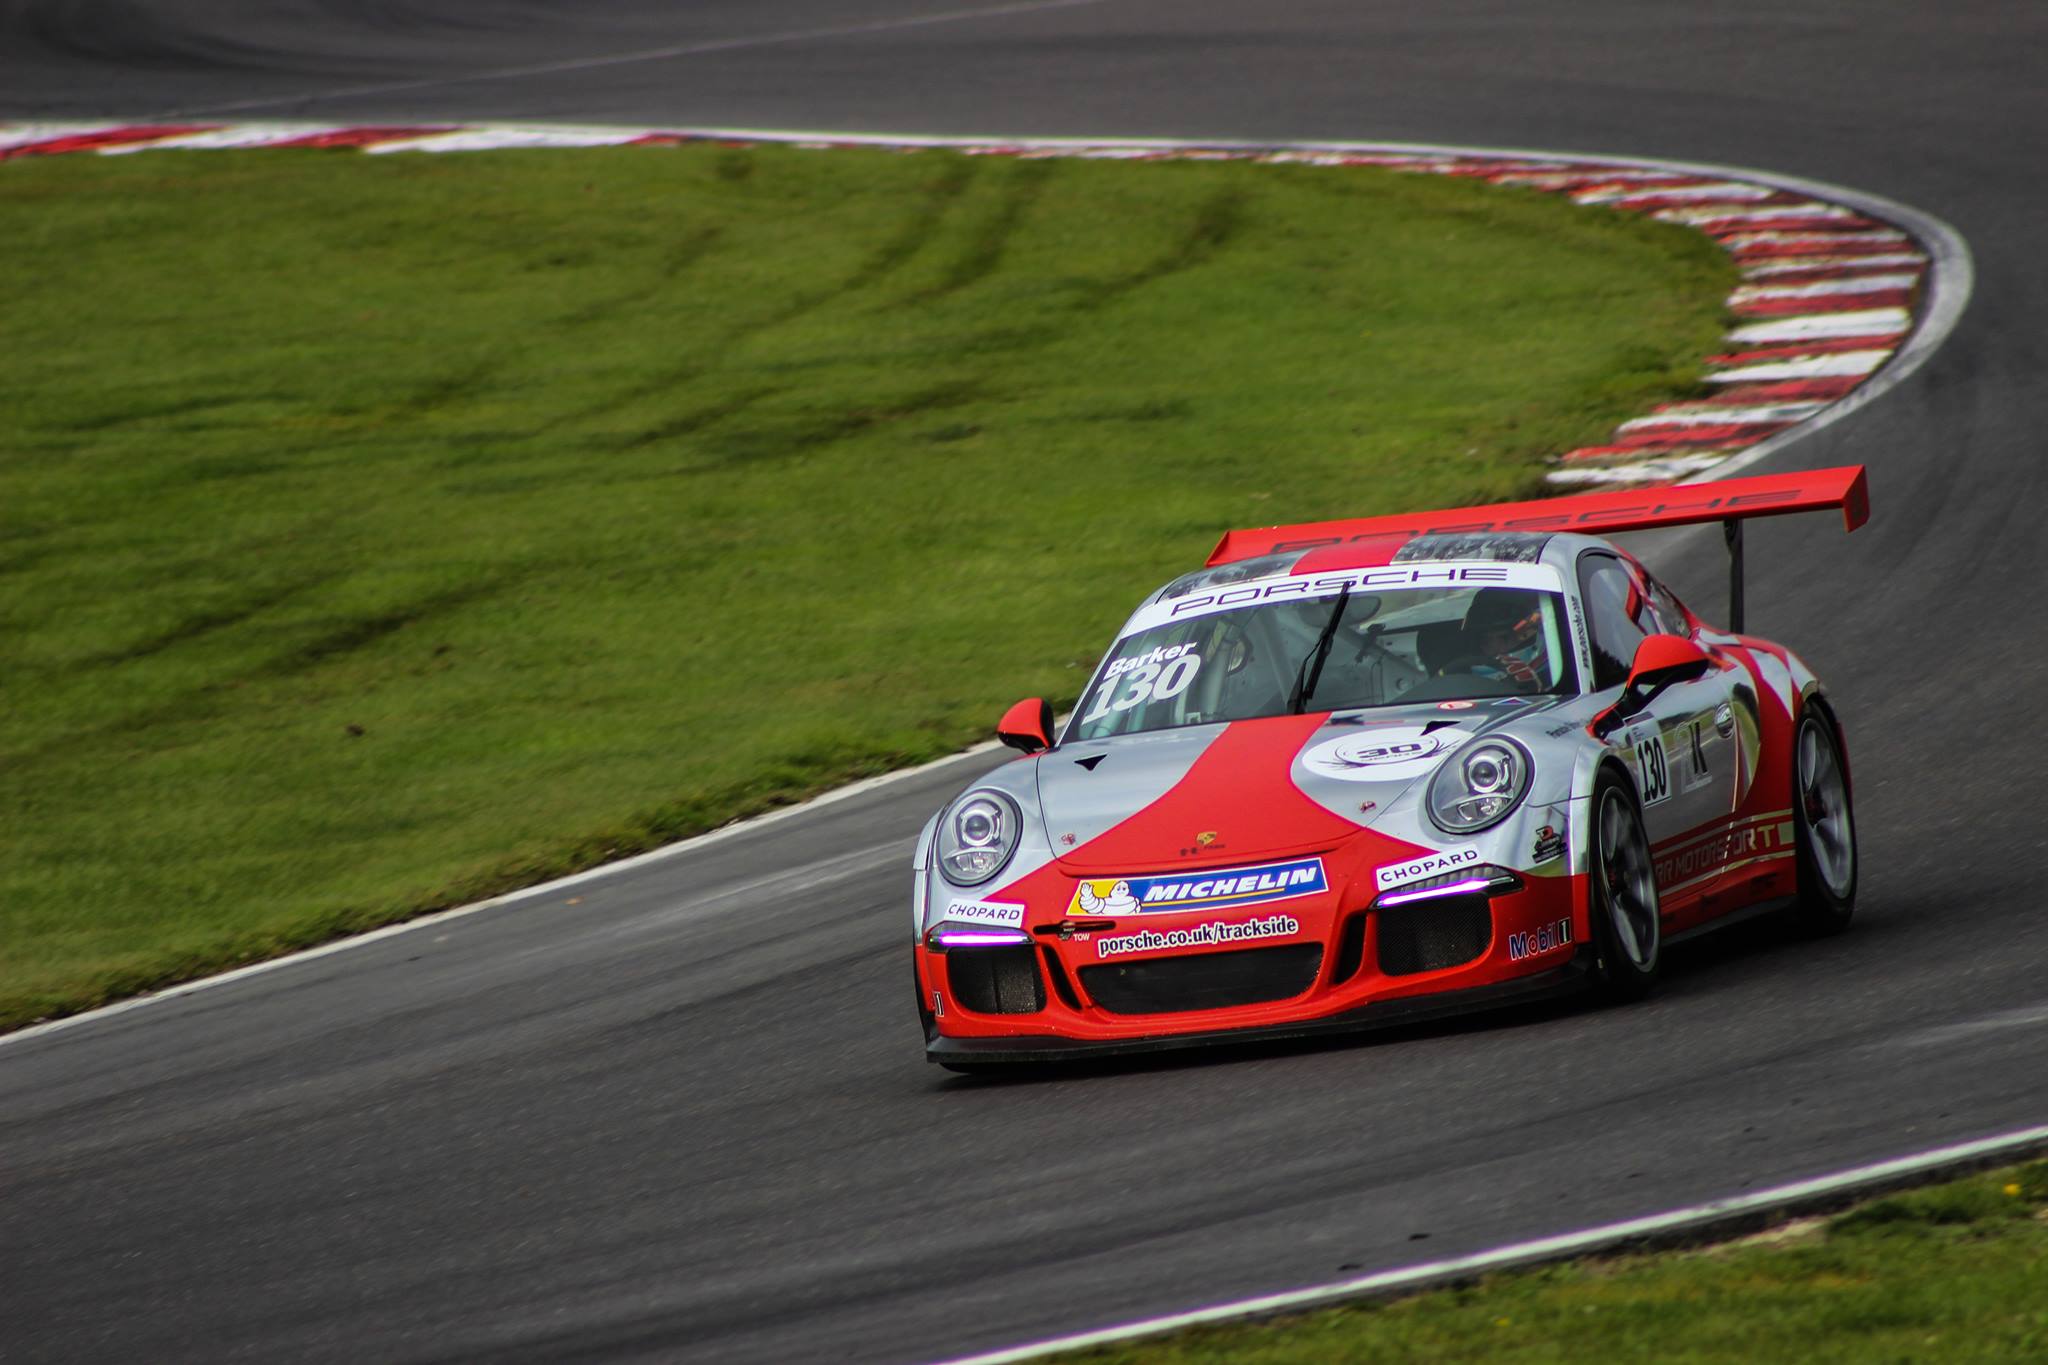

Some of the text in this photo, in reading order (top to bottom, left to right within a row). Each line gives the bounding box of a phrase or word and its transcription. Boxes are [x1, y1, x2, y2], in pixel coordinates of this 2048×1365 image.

[1170, 568, 1508, 616] PORSCHE
[1103, 642, 1197, 681] Barker
[1081, 654, 1200, 725] 130
[1357, 743, 1422, 759] 30
[1637, 736, 1667, 802] 130
[1143, 867, 1317, 902] MICHELIN
[1381, 850, 1478, 882] CHOPARD
[948, 904, 1020, 921] CHOPARD
[1073, 932, 1090, 942] TOW
[1099, 917, 1298, 957] porsche.co.uk/trackside
[1508, 921, 1557, 961] Mobil
